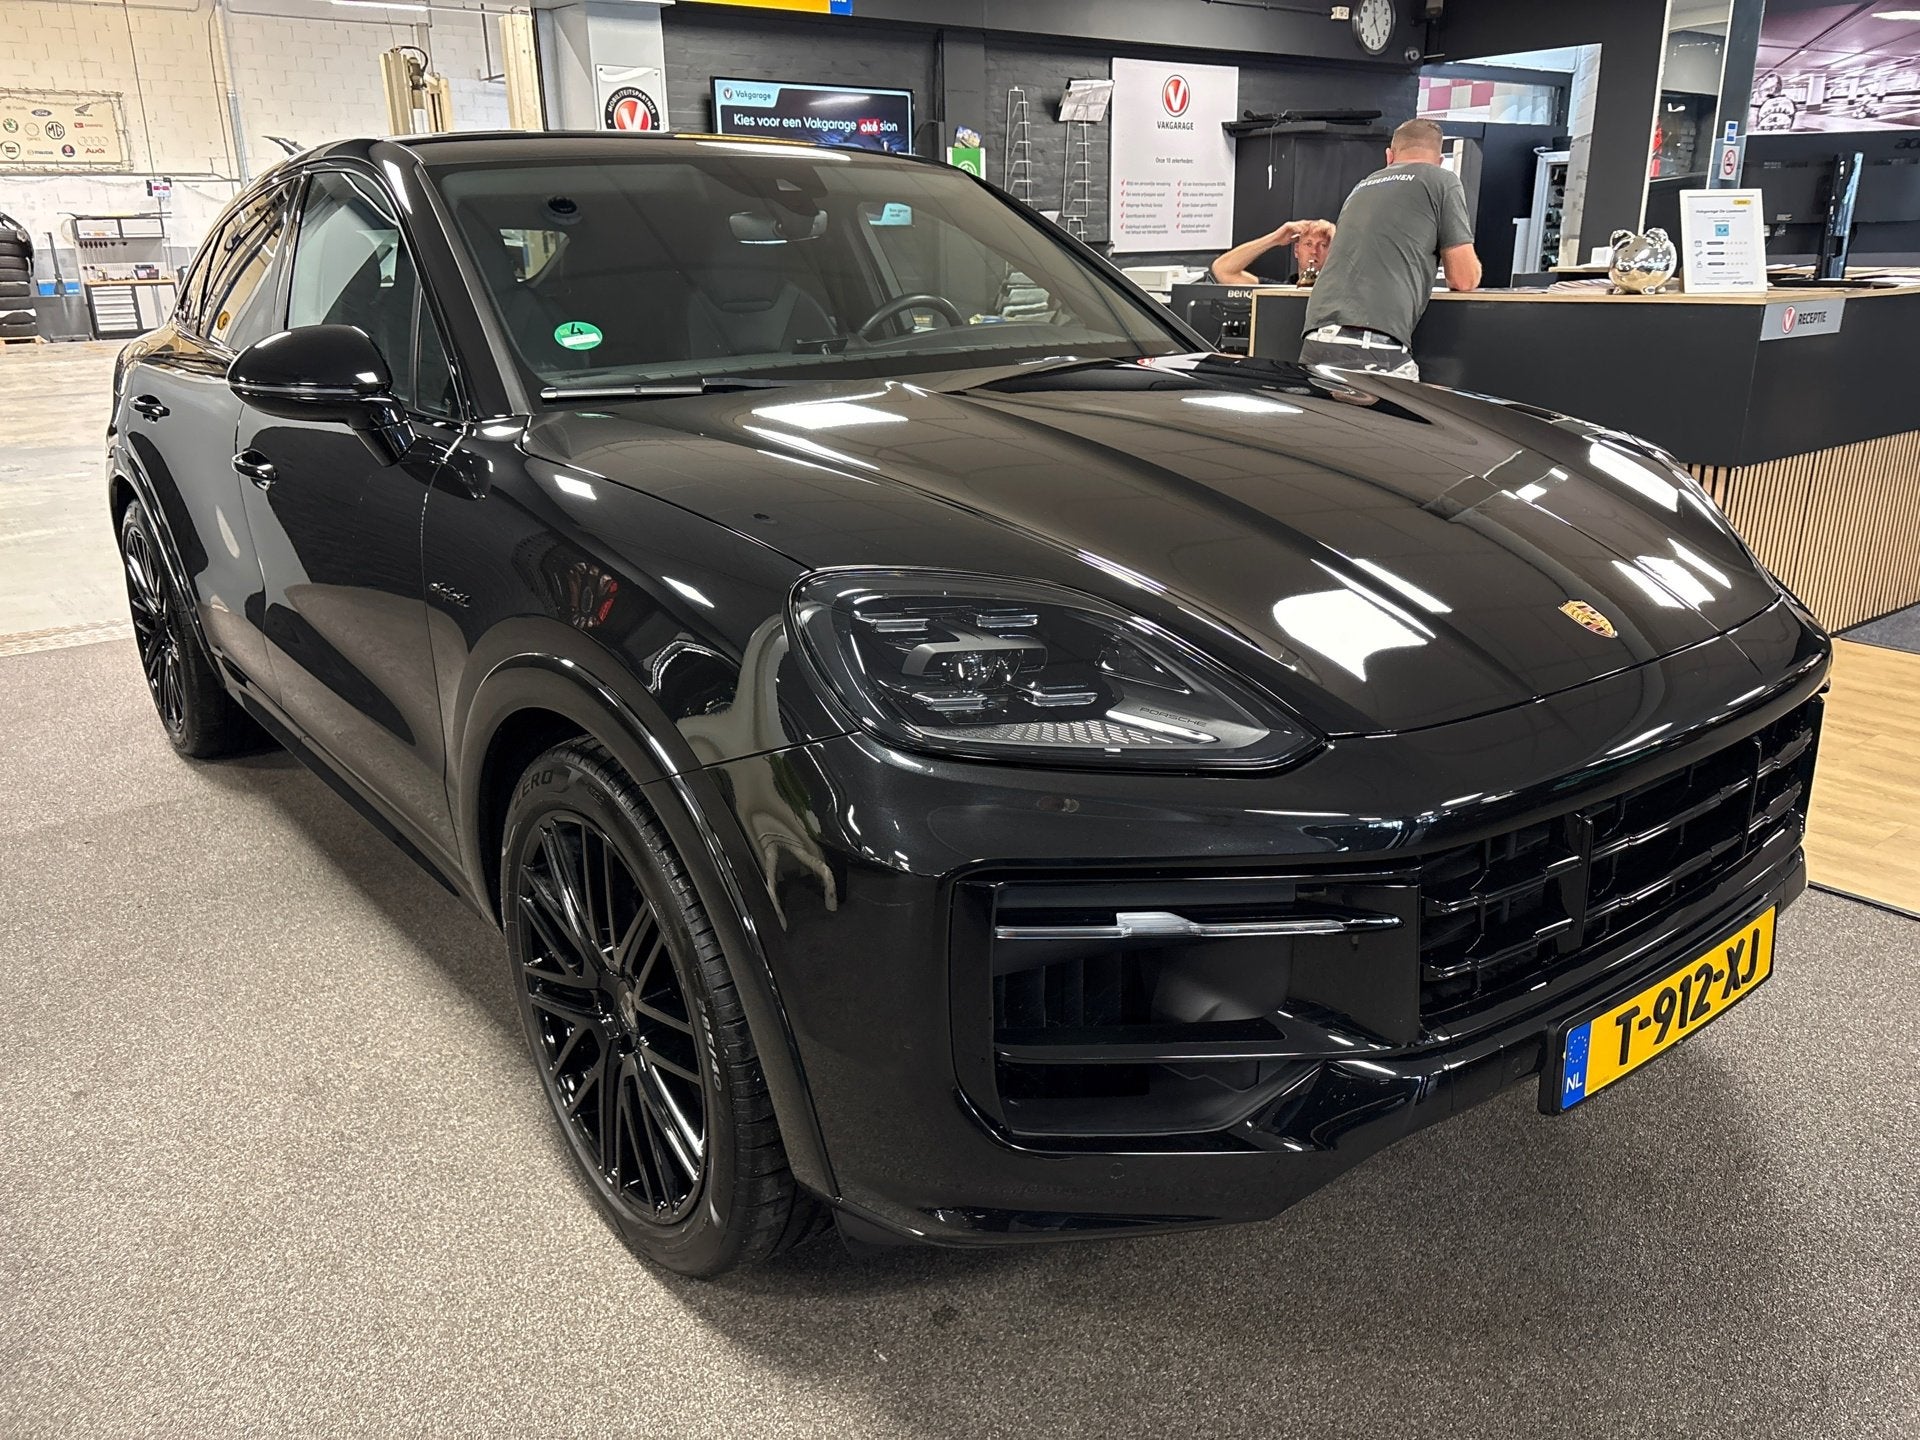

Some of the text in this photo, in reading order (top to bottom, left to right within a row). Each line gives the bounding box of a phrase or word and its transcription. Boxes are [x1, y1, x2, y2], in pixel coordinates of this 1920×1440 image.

[607, 89, 656, 114] MOBILITEITSPARTNER
[735, 90, 771, 100] Vakgarage
[733, 113, 898, 133] Kies voor een Vakgarage oké sion
[1157, 121, 1194, 130] VAKGARAGE
[1227, 290, 1253, 299] BenQ
[1797, 311, 1827, 325] RECEPTIE
[1140, 707, 1207, 727] PORSCHE
[1615, 928, 1760, 1066] T-912-XJ
[1565, 1072, 1583, 1094] NL
